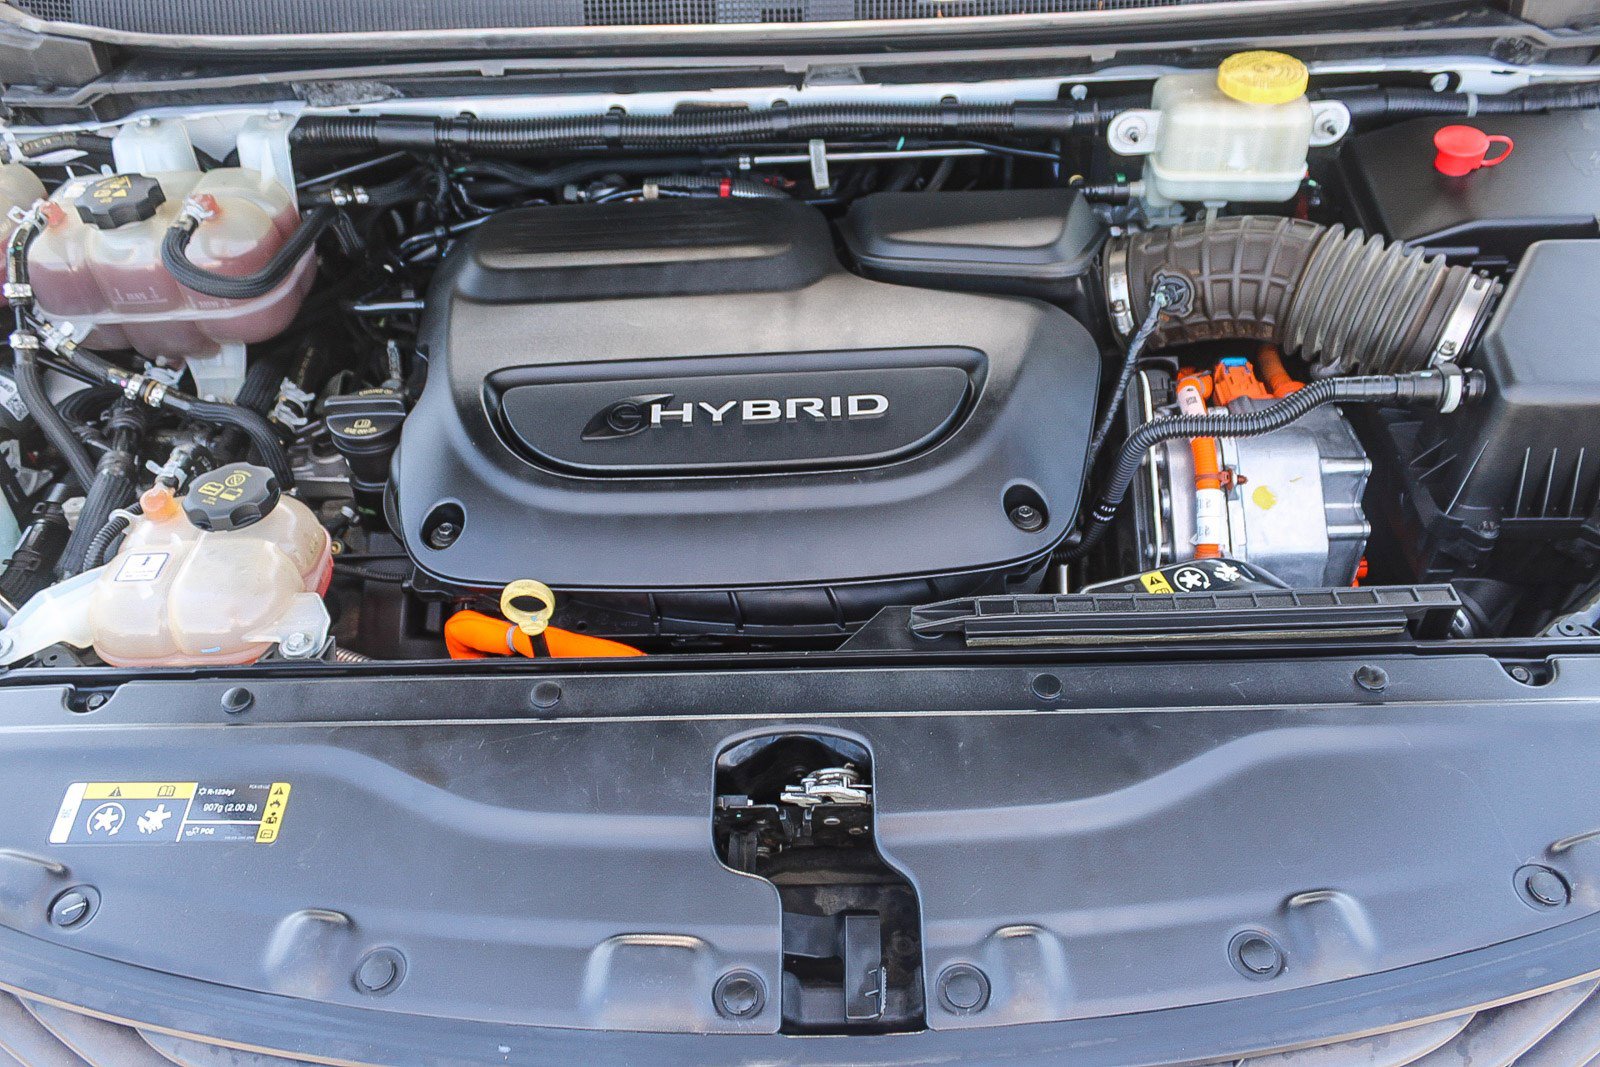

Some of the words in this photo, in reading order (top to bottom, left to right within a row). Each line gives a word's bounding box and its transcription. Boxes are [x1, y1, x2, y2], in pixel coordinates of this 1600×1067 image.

[651, 393, 891, 424] HYBRID
[203, 803, 223, 812] 907g
[224, 803, 245, 812] (2.00
[246, 803, 257, 812] lb)
